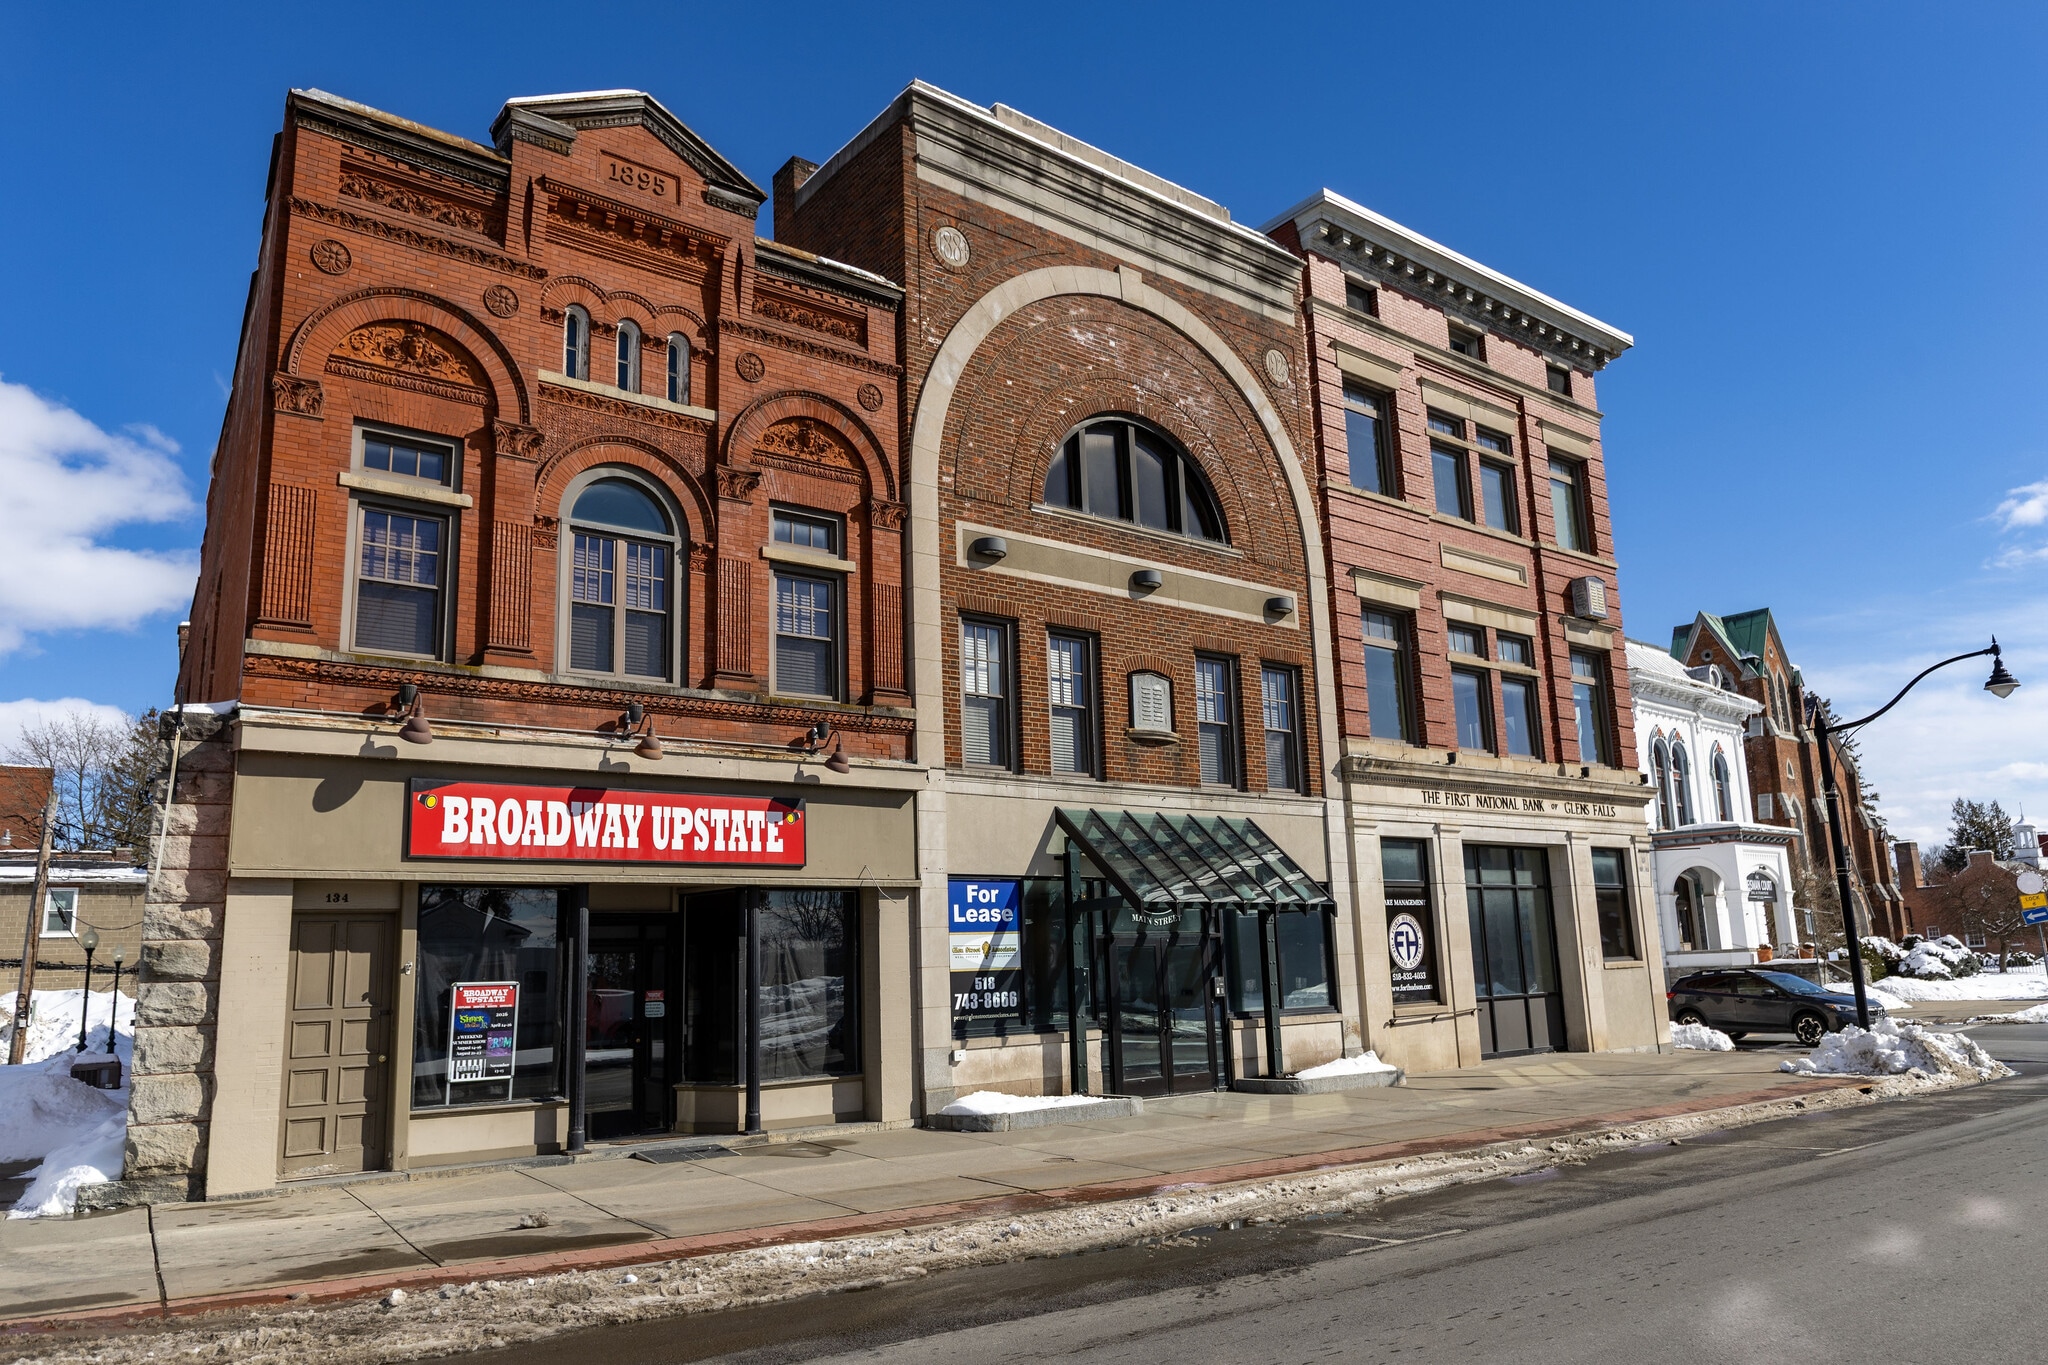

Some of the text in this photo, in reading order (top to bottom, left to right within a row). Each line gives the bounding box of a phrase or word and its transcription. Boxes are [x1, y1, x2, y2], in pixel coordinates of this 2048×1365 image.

[608, 162, 666, 196] 1895
[1421, 790, 1441, 805] THE
[1445, 792, 1471, 807] FIRST
[1476, 795, 1520, 810] NATIONAL
[1522, 798, 1545, 812] BANK
[1564, 802, 1590, 816] GLENS
[1592, 804, 1616, 818] FALLS
[441, 795, 784, 853] BROADWAY UPSTATE
[325, 893, 349, 903] 134
[966, 885, 1000, 903] For
[953, 904, 1014, 923] Lease
[1131, 913, 1182, 927] MAIN STREET
[974, 976, 996, 990] 518
[463, 989, 509, 997] BROADWAY
[954, 991, 1018, 1011] 743-8666
